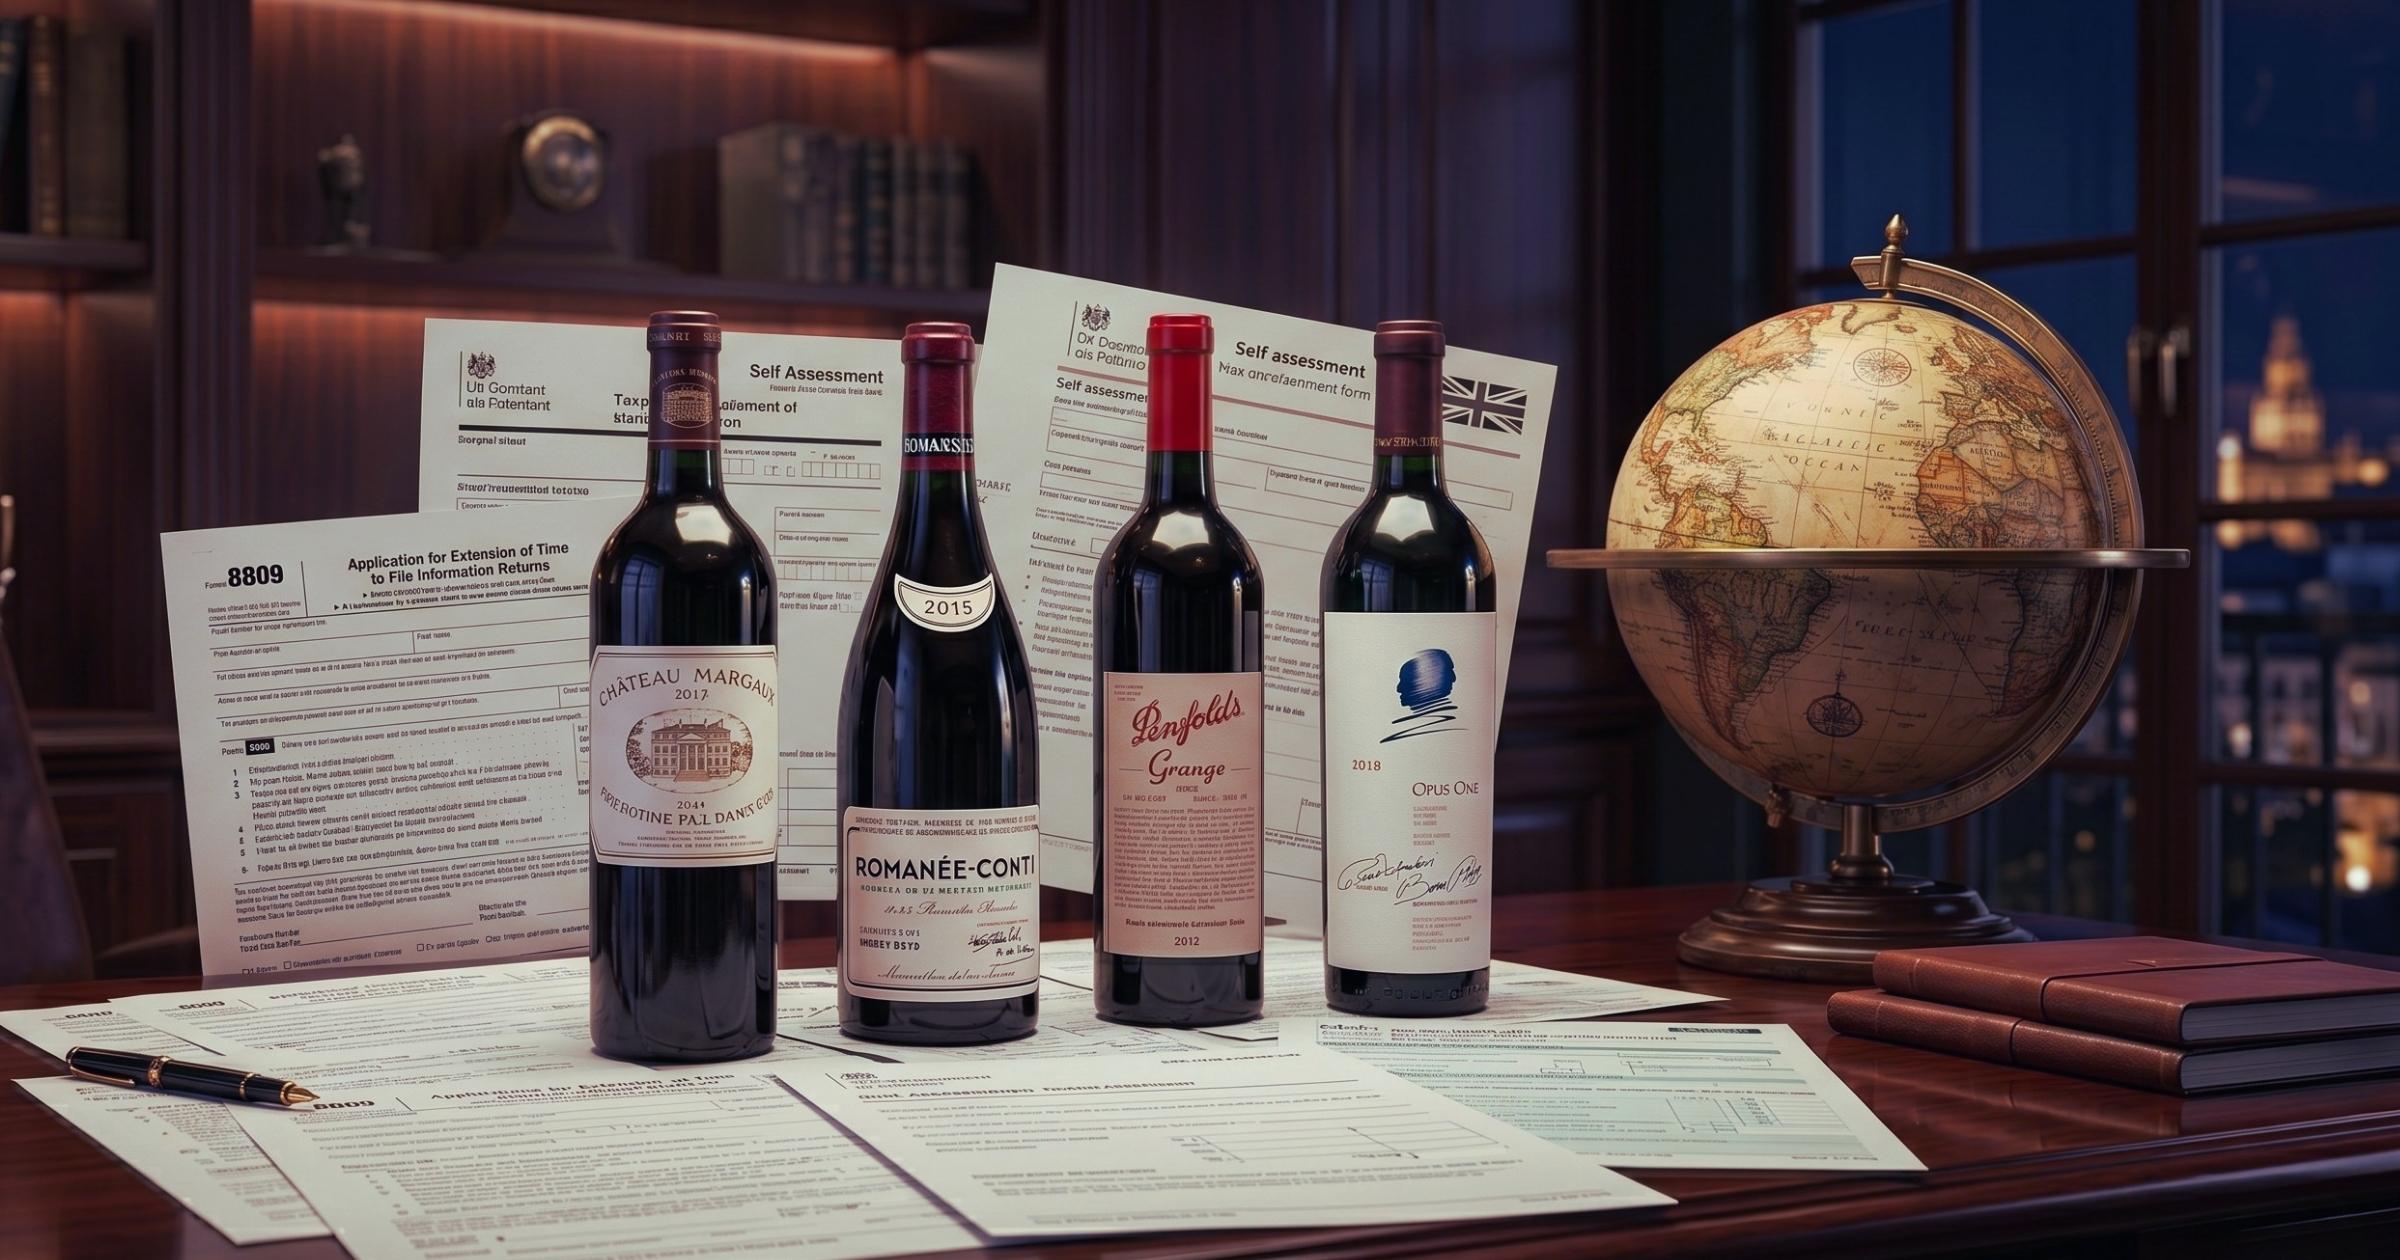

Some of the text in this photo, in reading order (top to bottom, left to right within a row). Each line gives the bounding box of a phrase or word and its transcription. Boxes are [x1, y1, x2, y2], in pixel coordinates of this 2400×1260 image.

[1235, 341, 1366, 379] Self assessment
[750, 364, 884, 384] Self Assessment
[1056, 377, 1082, 391] Self
[1341, 383, 1371, 401] form
[784, 401, 797, 413] of
[348, 542, 569, 572] Application for Extension of Time
[228, 564, 284, 588] 8809
[371, 560, 550, 586] to File Information Returns
[924, 600, 973, 616] 2015
[599, 668, 777, 707] CHÂTEAU MARGAUX
[675, 689, 709, 701] 2017
[1131, 690, 1243, 747] Penfolds
[1149, 749, 1226, 785] Grange
[1352, 759, 1381, 771] 2018
[233, 779, 240, 788] 2
[856, 855, 1035, 881] ROMANÉE-CONTI
[1174, 936, 1200, 946] 2012
